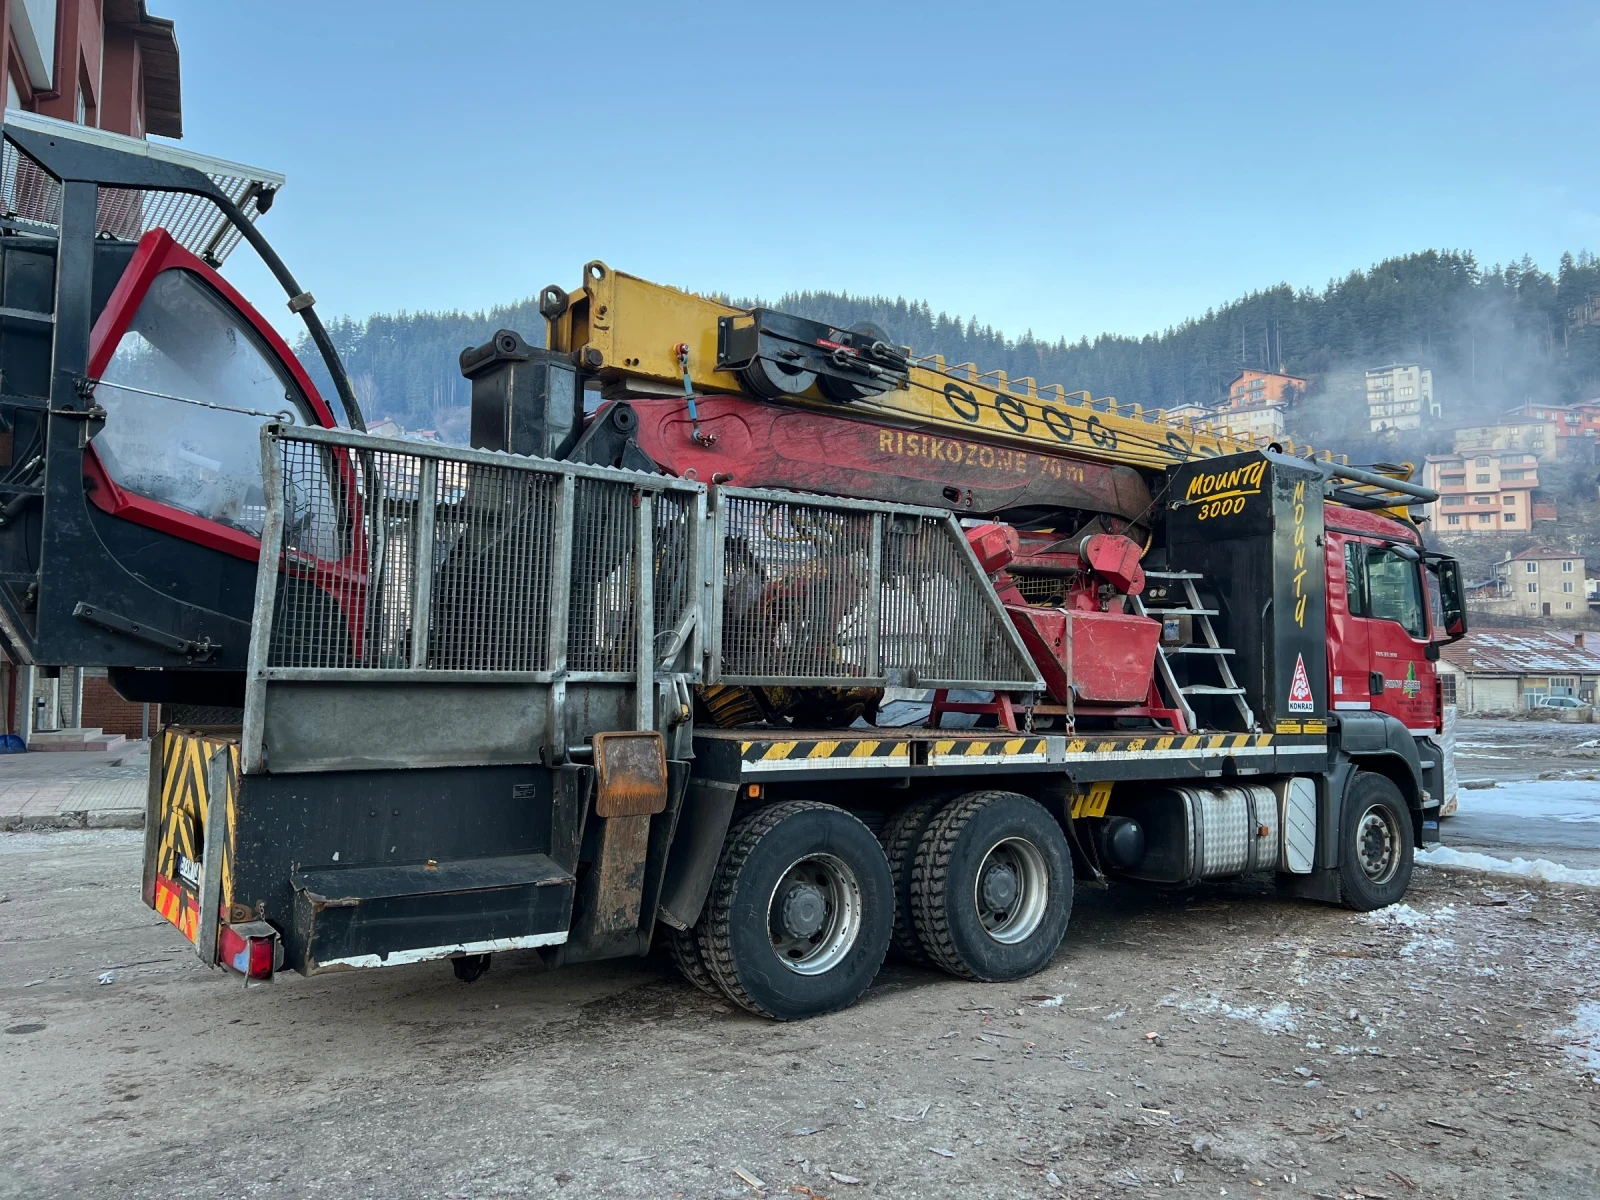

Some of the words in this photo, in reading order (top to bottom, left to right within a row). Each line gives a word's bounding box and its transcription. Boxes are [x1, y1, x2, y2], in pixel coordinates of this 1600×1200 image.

[879, 429, 1027, 474] RISIKOZONE
[1185, 460, 1268, 500] MOUNTY
[1198, 496, 1246, 520] 3000
[1290, 702, 1312, 710] KONRAD
